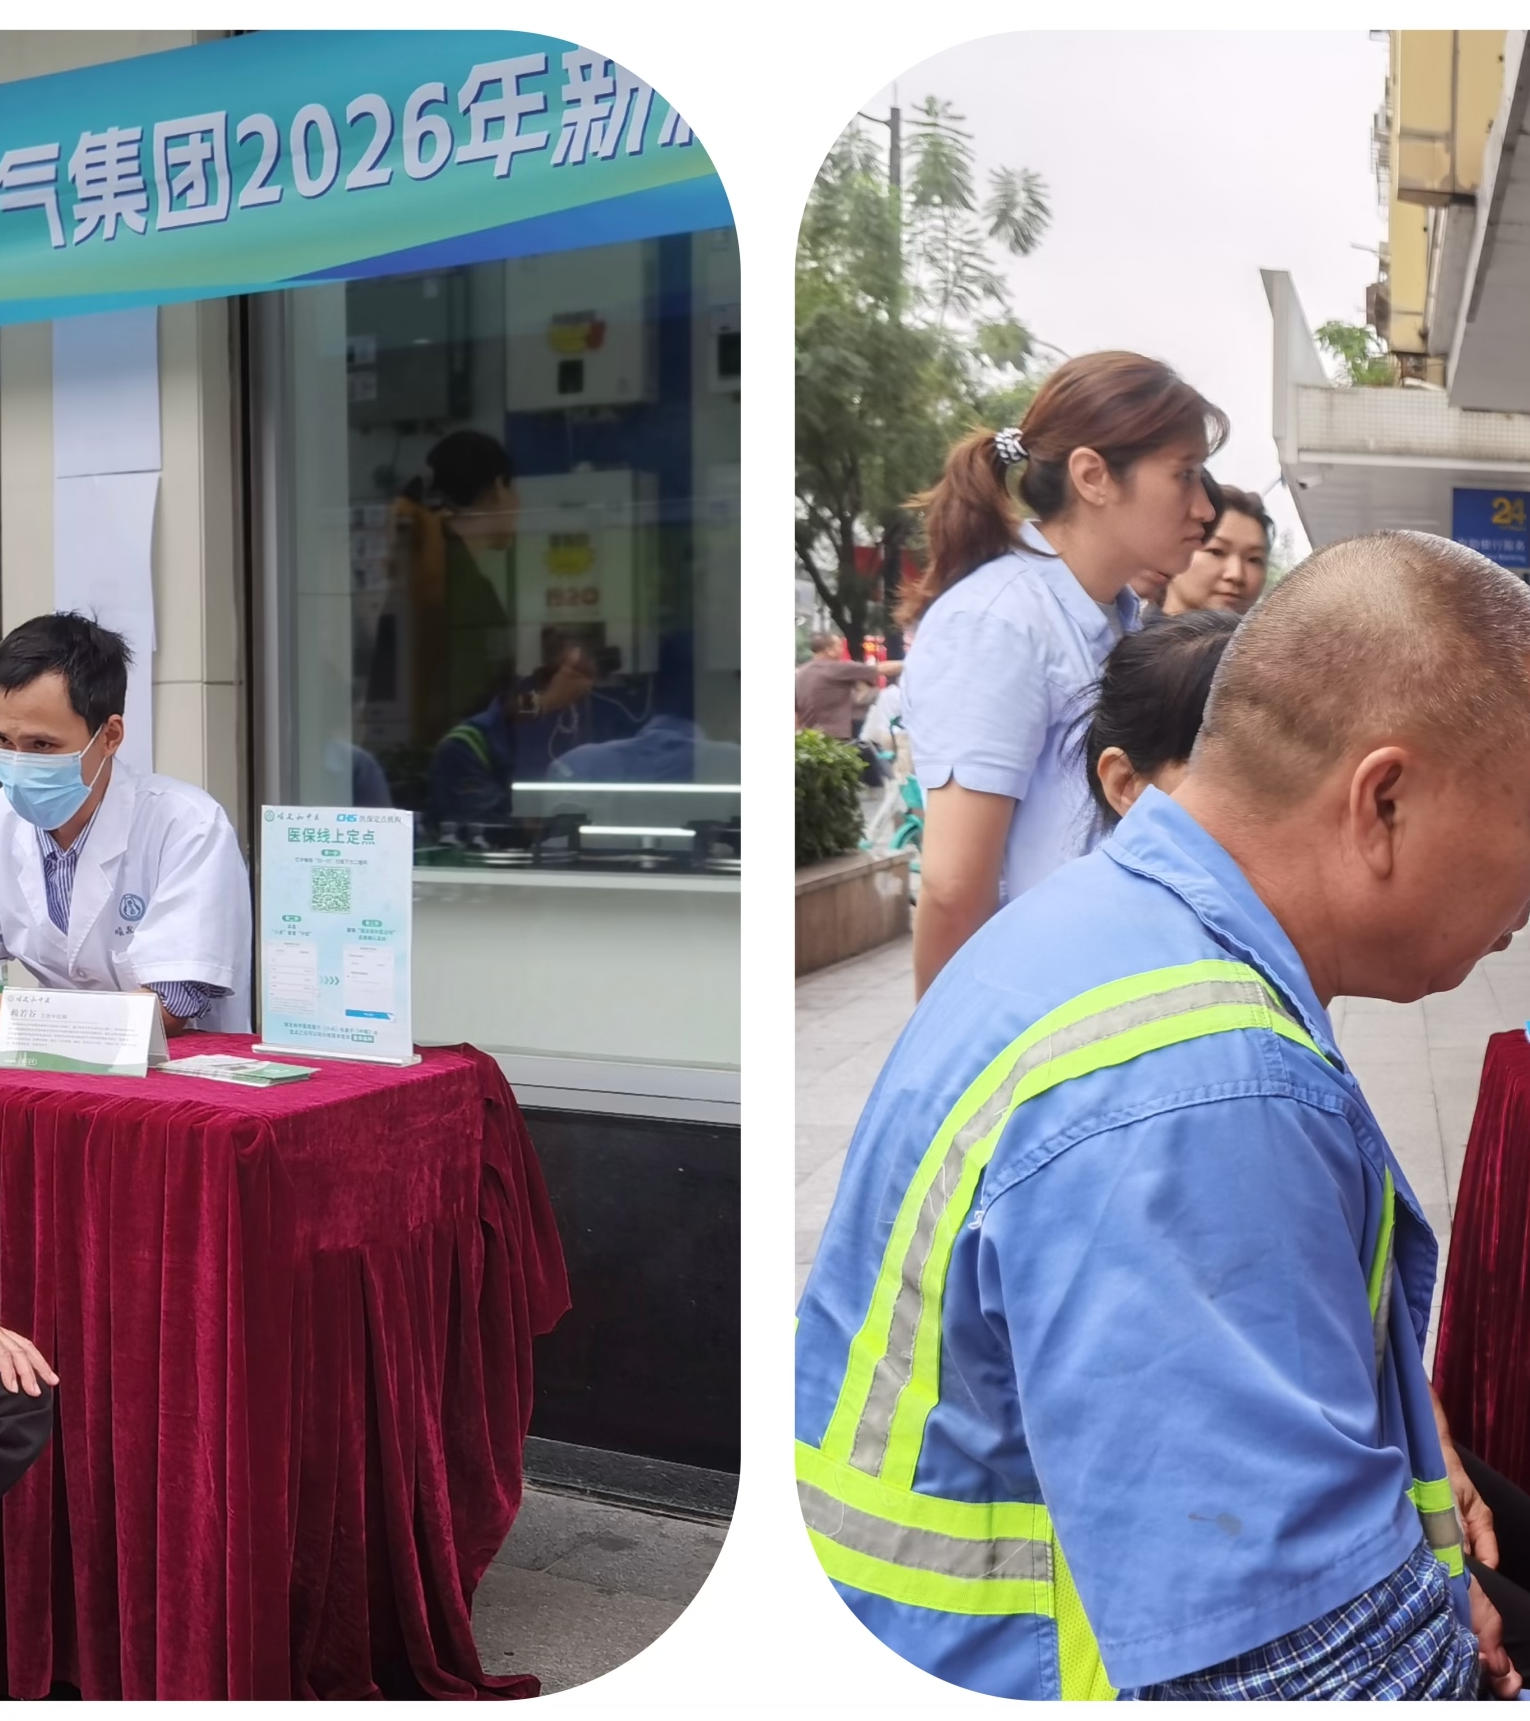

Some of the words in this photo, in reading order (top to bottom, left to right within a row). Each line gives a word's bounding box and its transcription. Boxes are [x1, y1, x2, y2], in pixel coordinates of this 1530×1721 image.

[1491, 496, 1527, 527] 24
[287, 827, 376, 846] 医保线上定点
